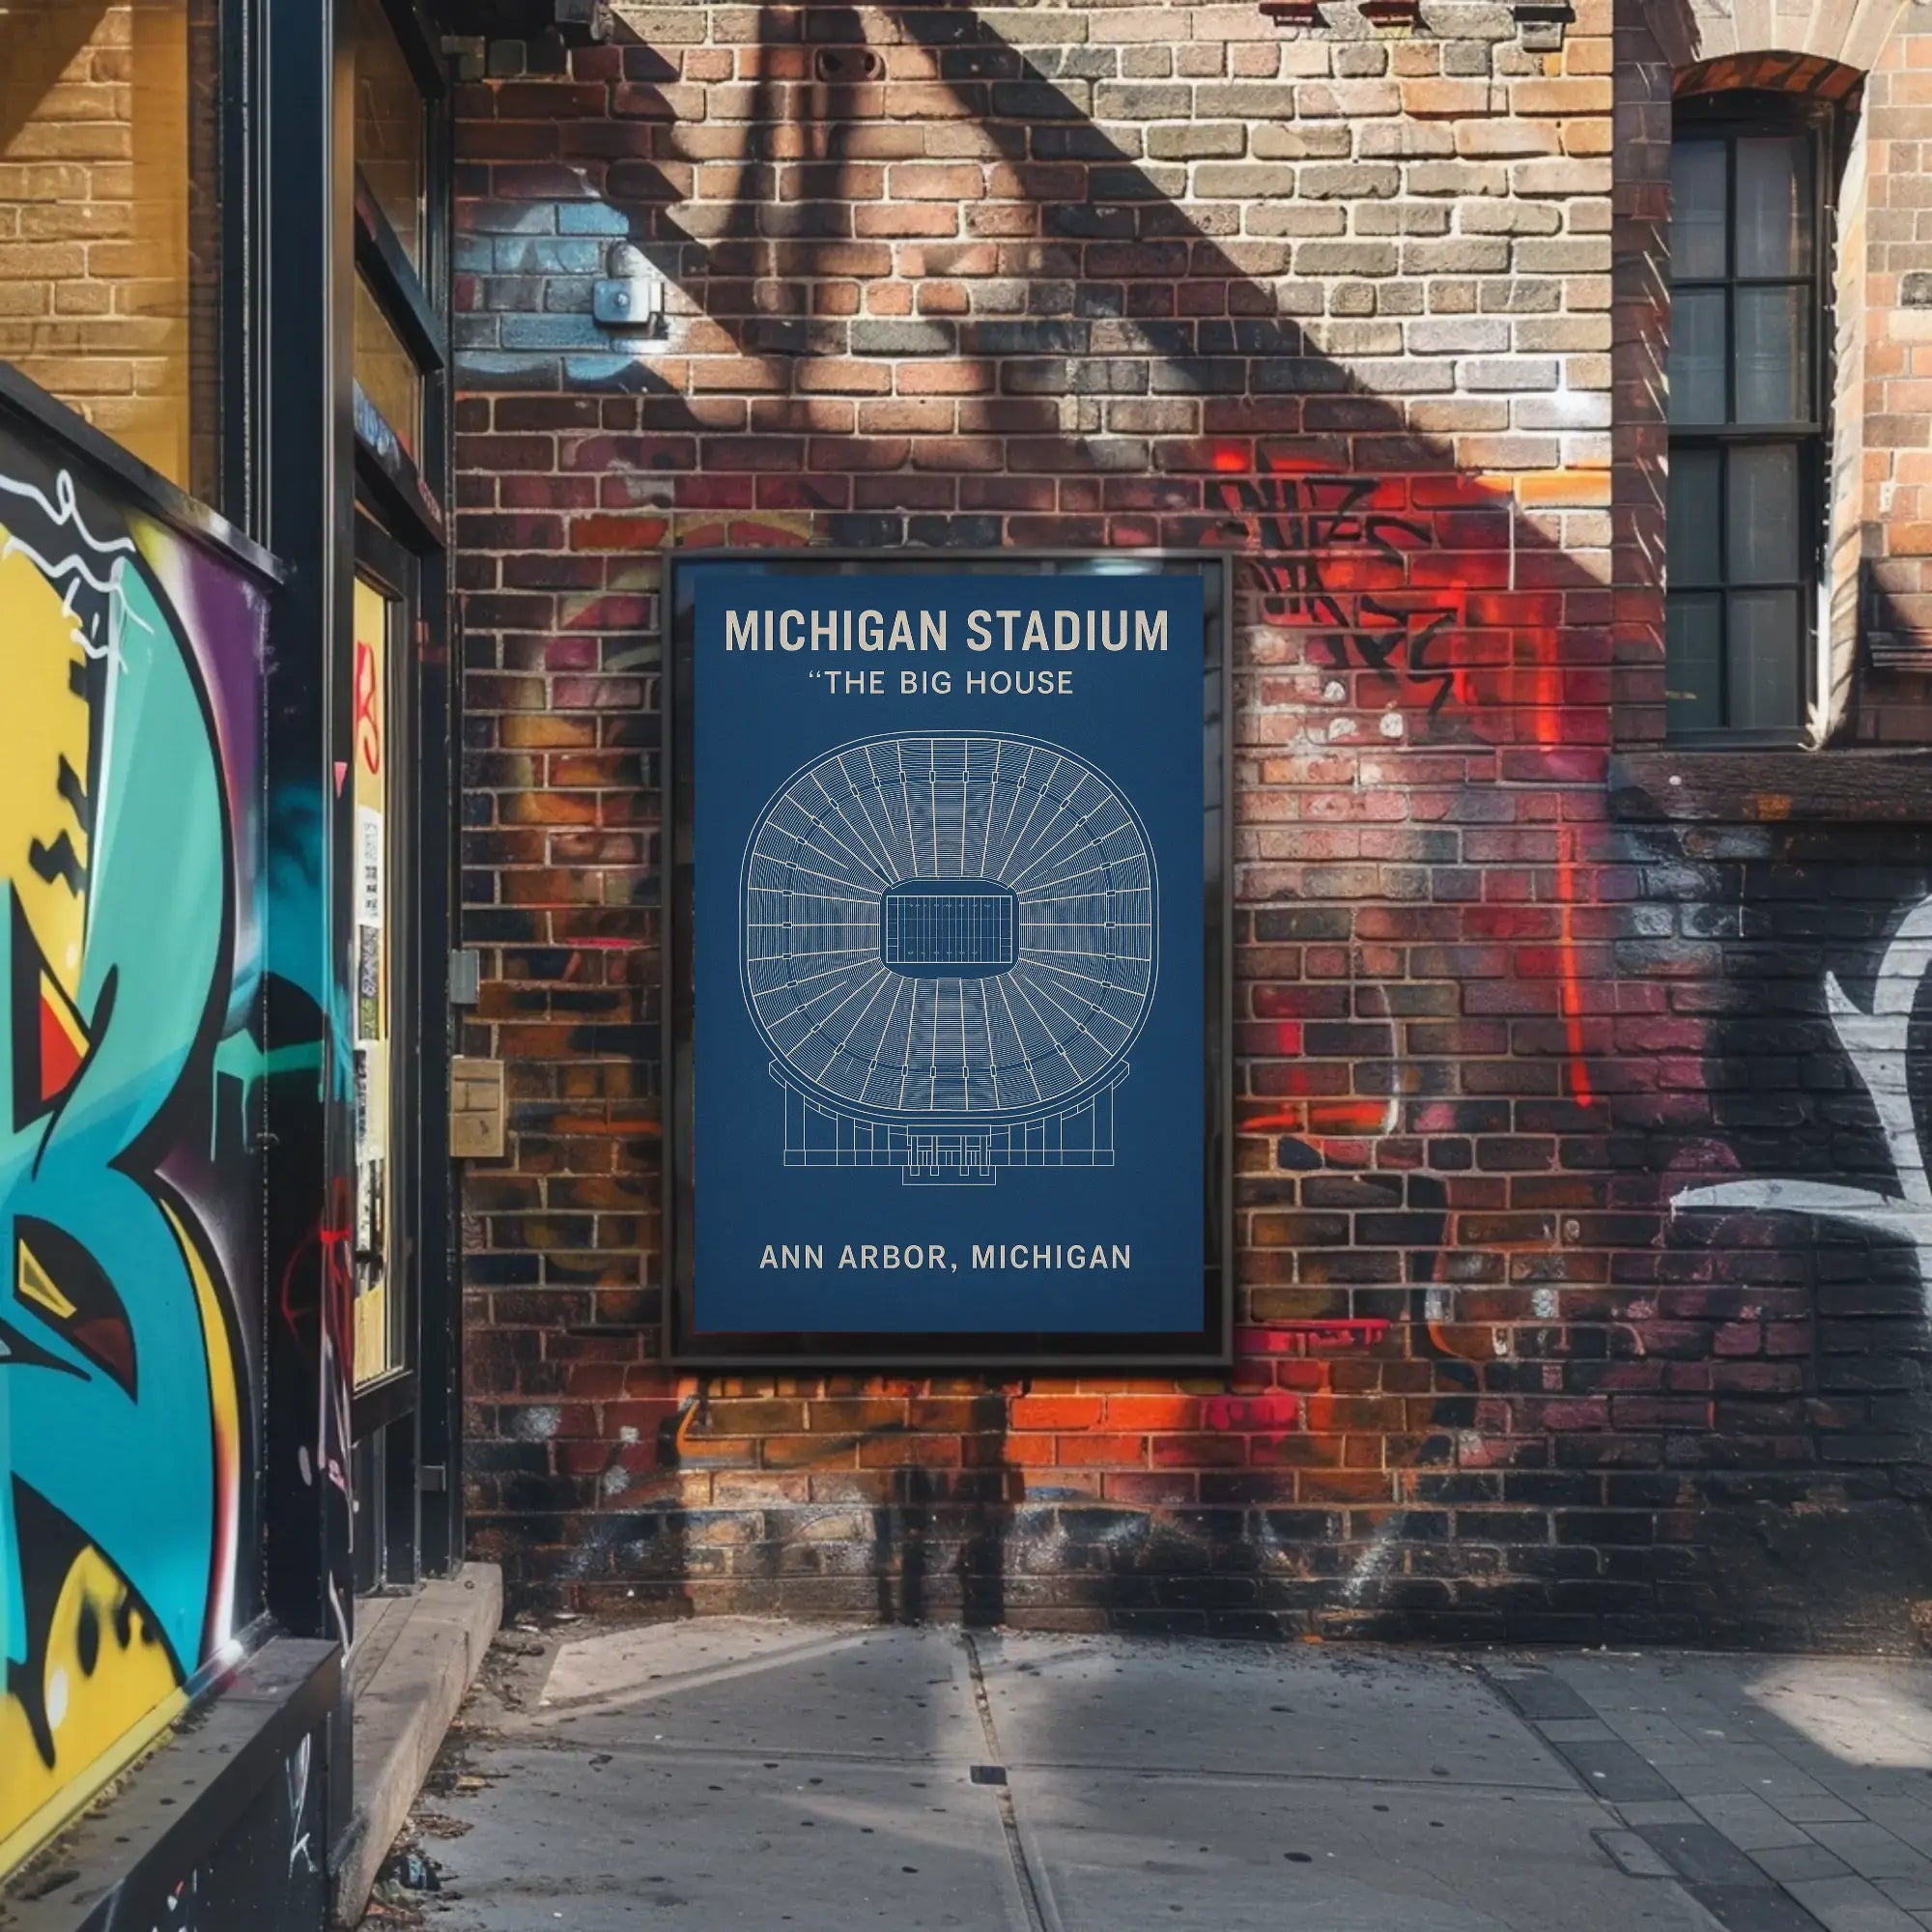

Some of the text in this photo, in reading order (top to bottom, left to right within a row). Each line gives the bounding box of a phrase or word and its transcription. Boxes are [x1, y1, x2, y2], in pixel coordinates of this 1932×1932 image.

[725, 609, 1168, 652] MICHIGAN STADIUM
[900, 669, 952, 695] BIG
[966, 669, 1073, 695] HOUSE
[759, 1244, 1130, 1273] ANN ARBOR, MICHIGAN
